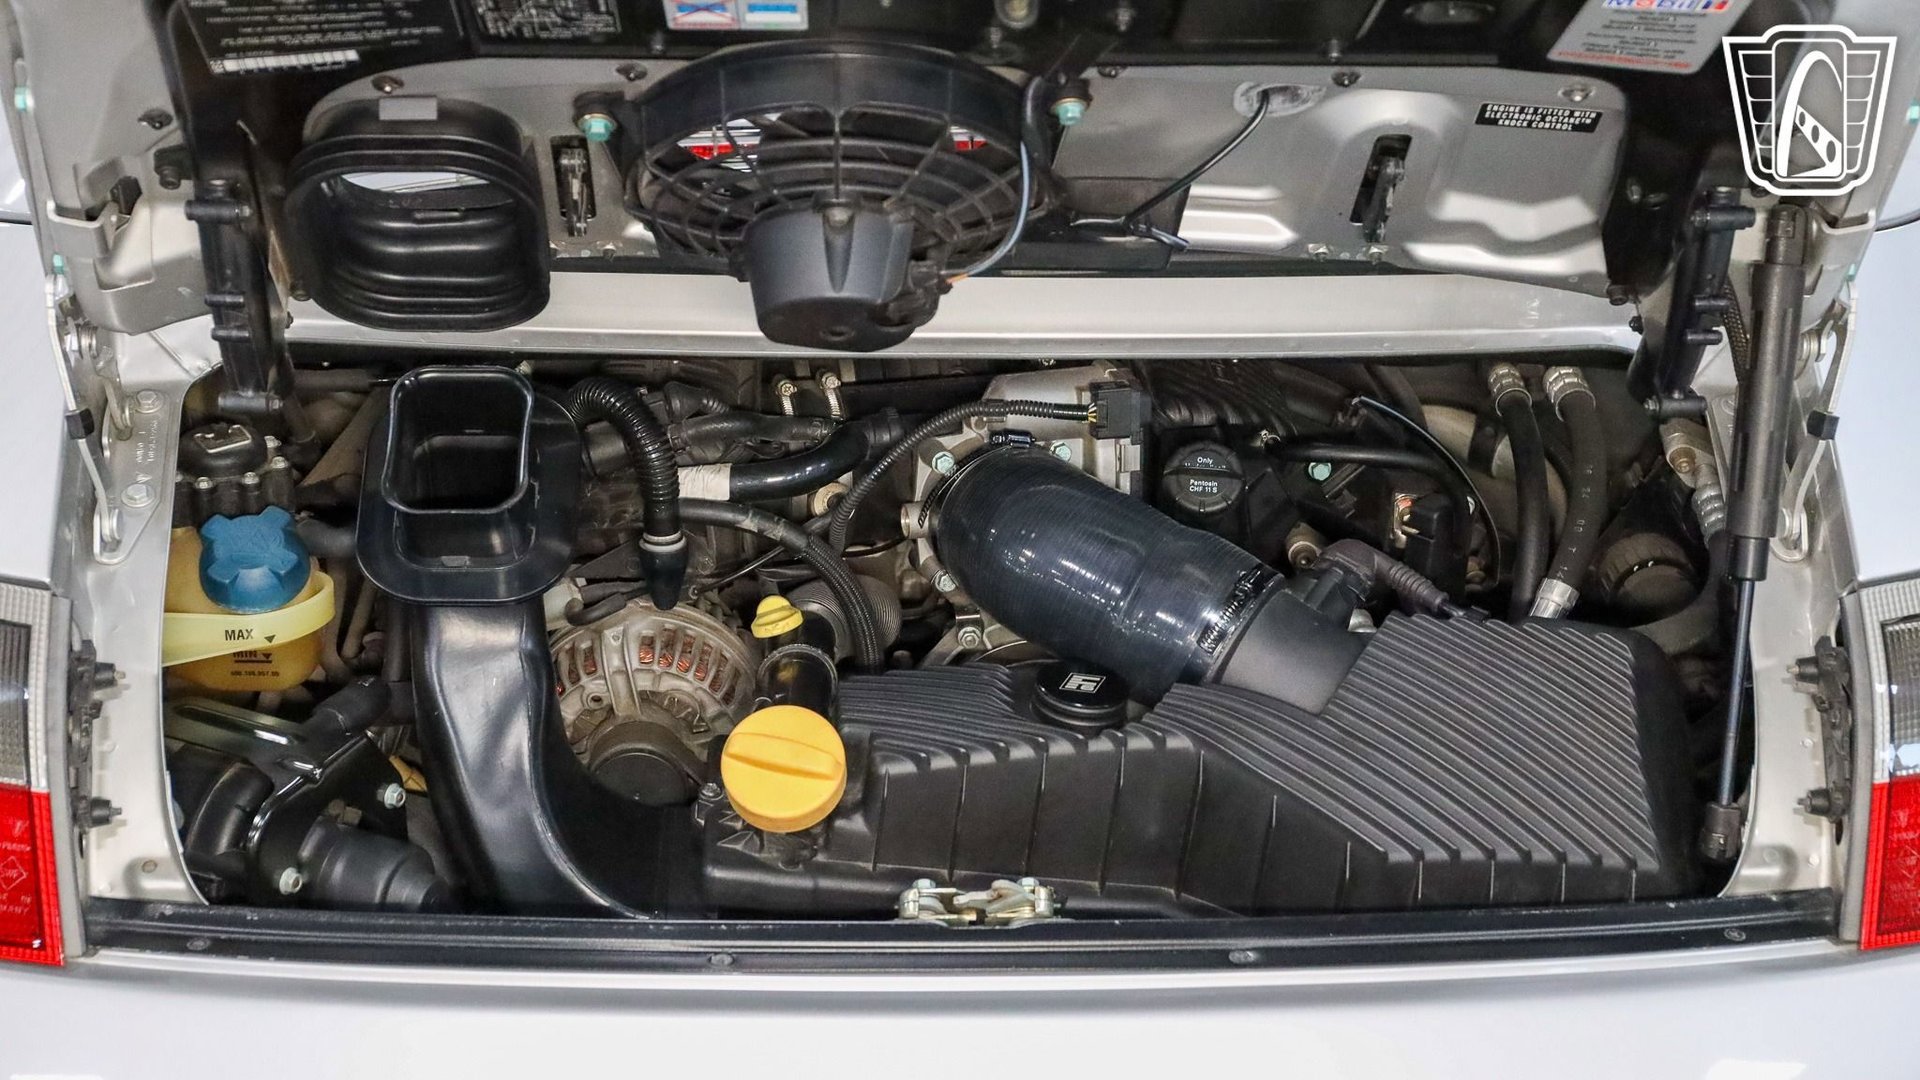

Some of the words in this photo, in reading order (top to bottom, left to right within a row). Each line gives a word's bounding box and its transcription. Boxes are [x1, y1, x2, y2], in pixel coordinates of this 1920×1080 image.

[1484, 111, 1542, 120] ELECTRONIC
[1486, 104, 1521, 113] ENGINE
[1537, 107, 1571, 116] FITTED
[1573, 110, 1597, 118] WITH
[1497, 119, 1528, 127] KNOCK
[1531, 121, 1573, 130] CONTROL
[1197, 456, 1213, 464] Only
[224, 628, 253, 641] MAX
